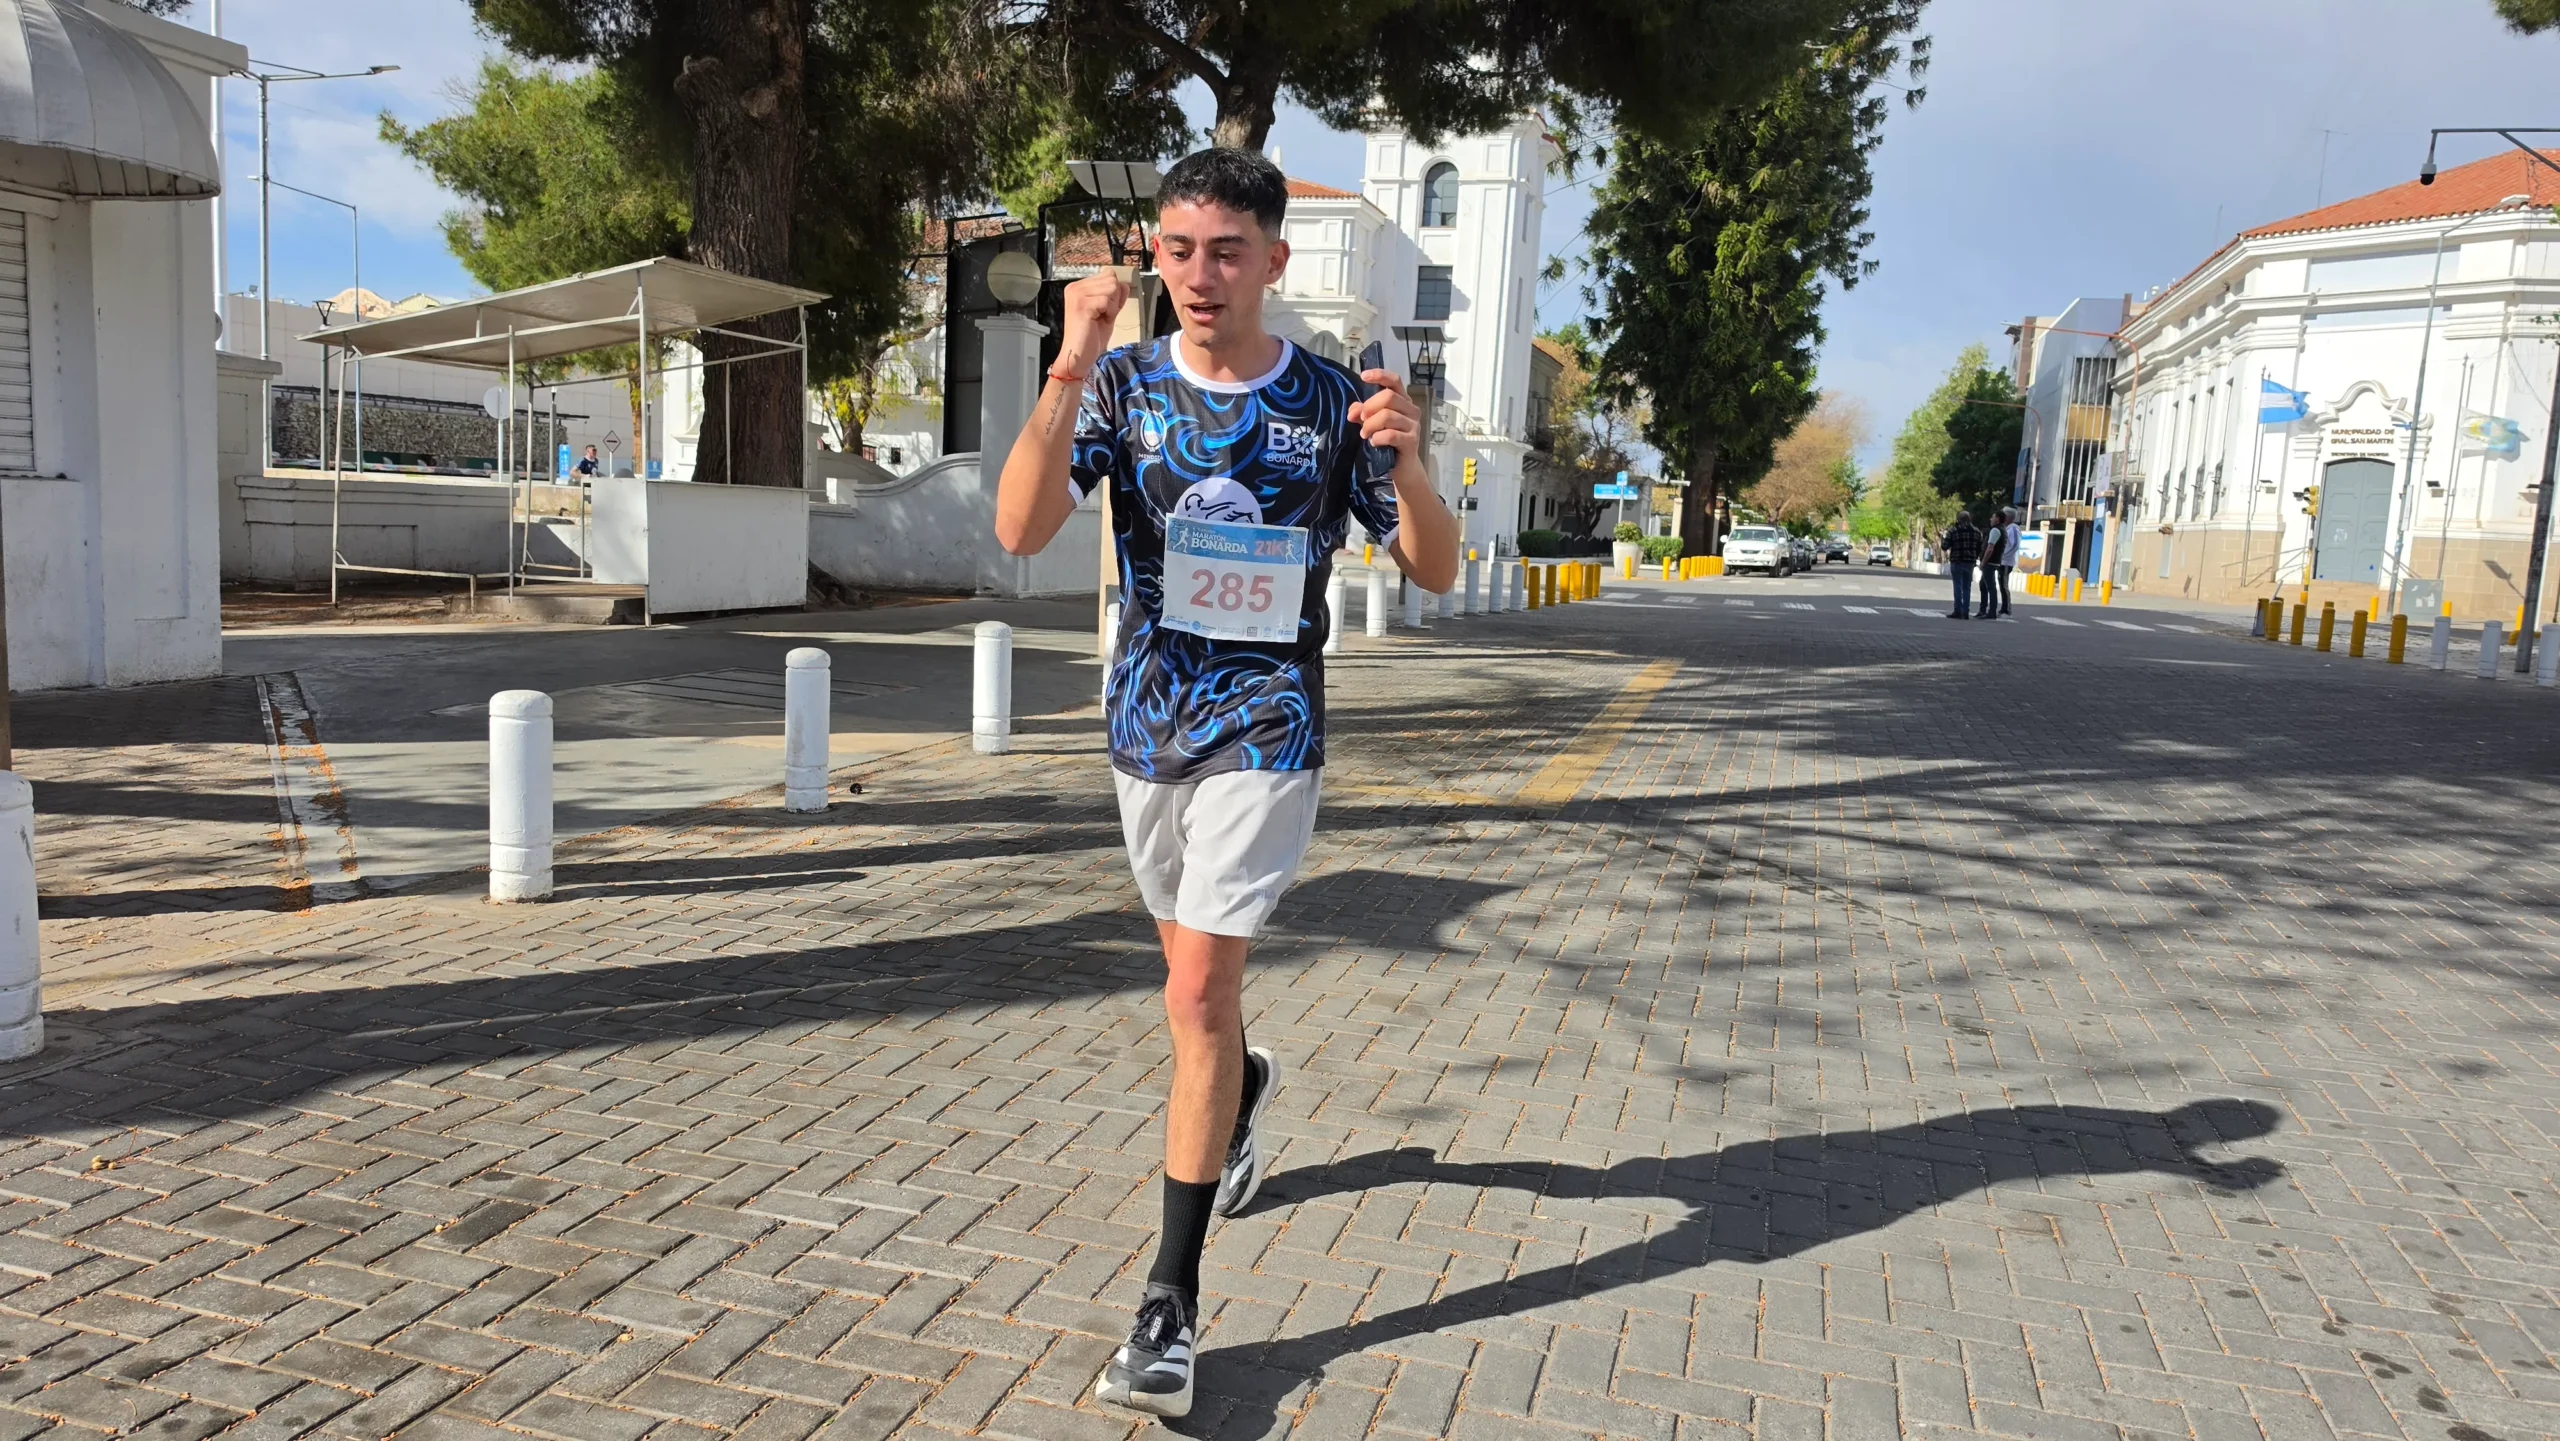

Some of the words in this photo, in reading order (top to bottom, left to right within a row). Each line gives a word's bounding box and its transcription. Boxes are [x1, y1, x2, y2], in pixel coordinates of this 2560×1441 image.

[1266, 453, 1318, 468] BONARDA
[1192, 532, 1226, 542] MARATÓN
[1191, 538, 1248, 554] BONARDA
[1254, 540, 1286, 556] 21K
[1189, 568, 1275, 614] 285
